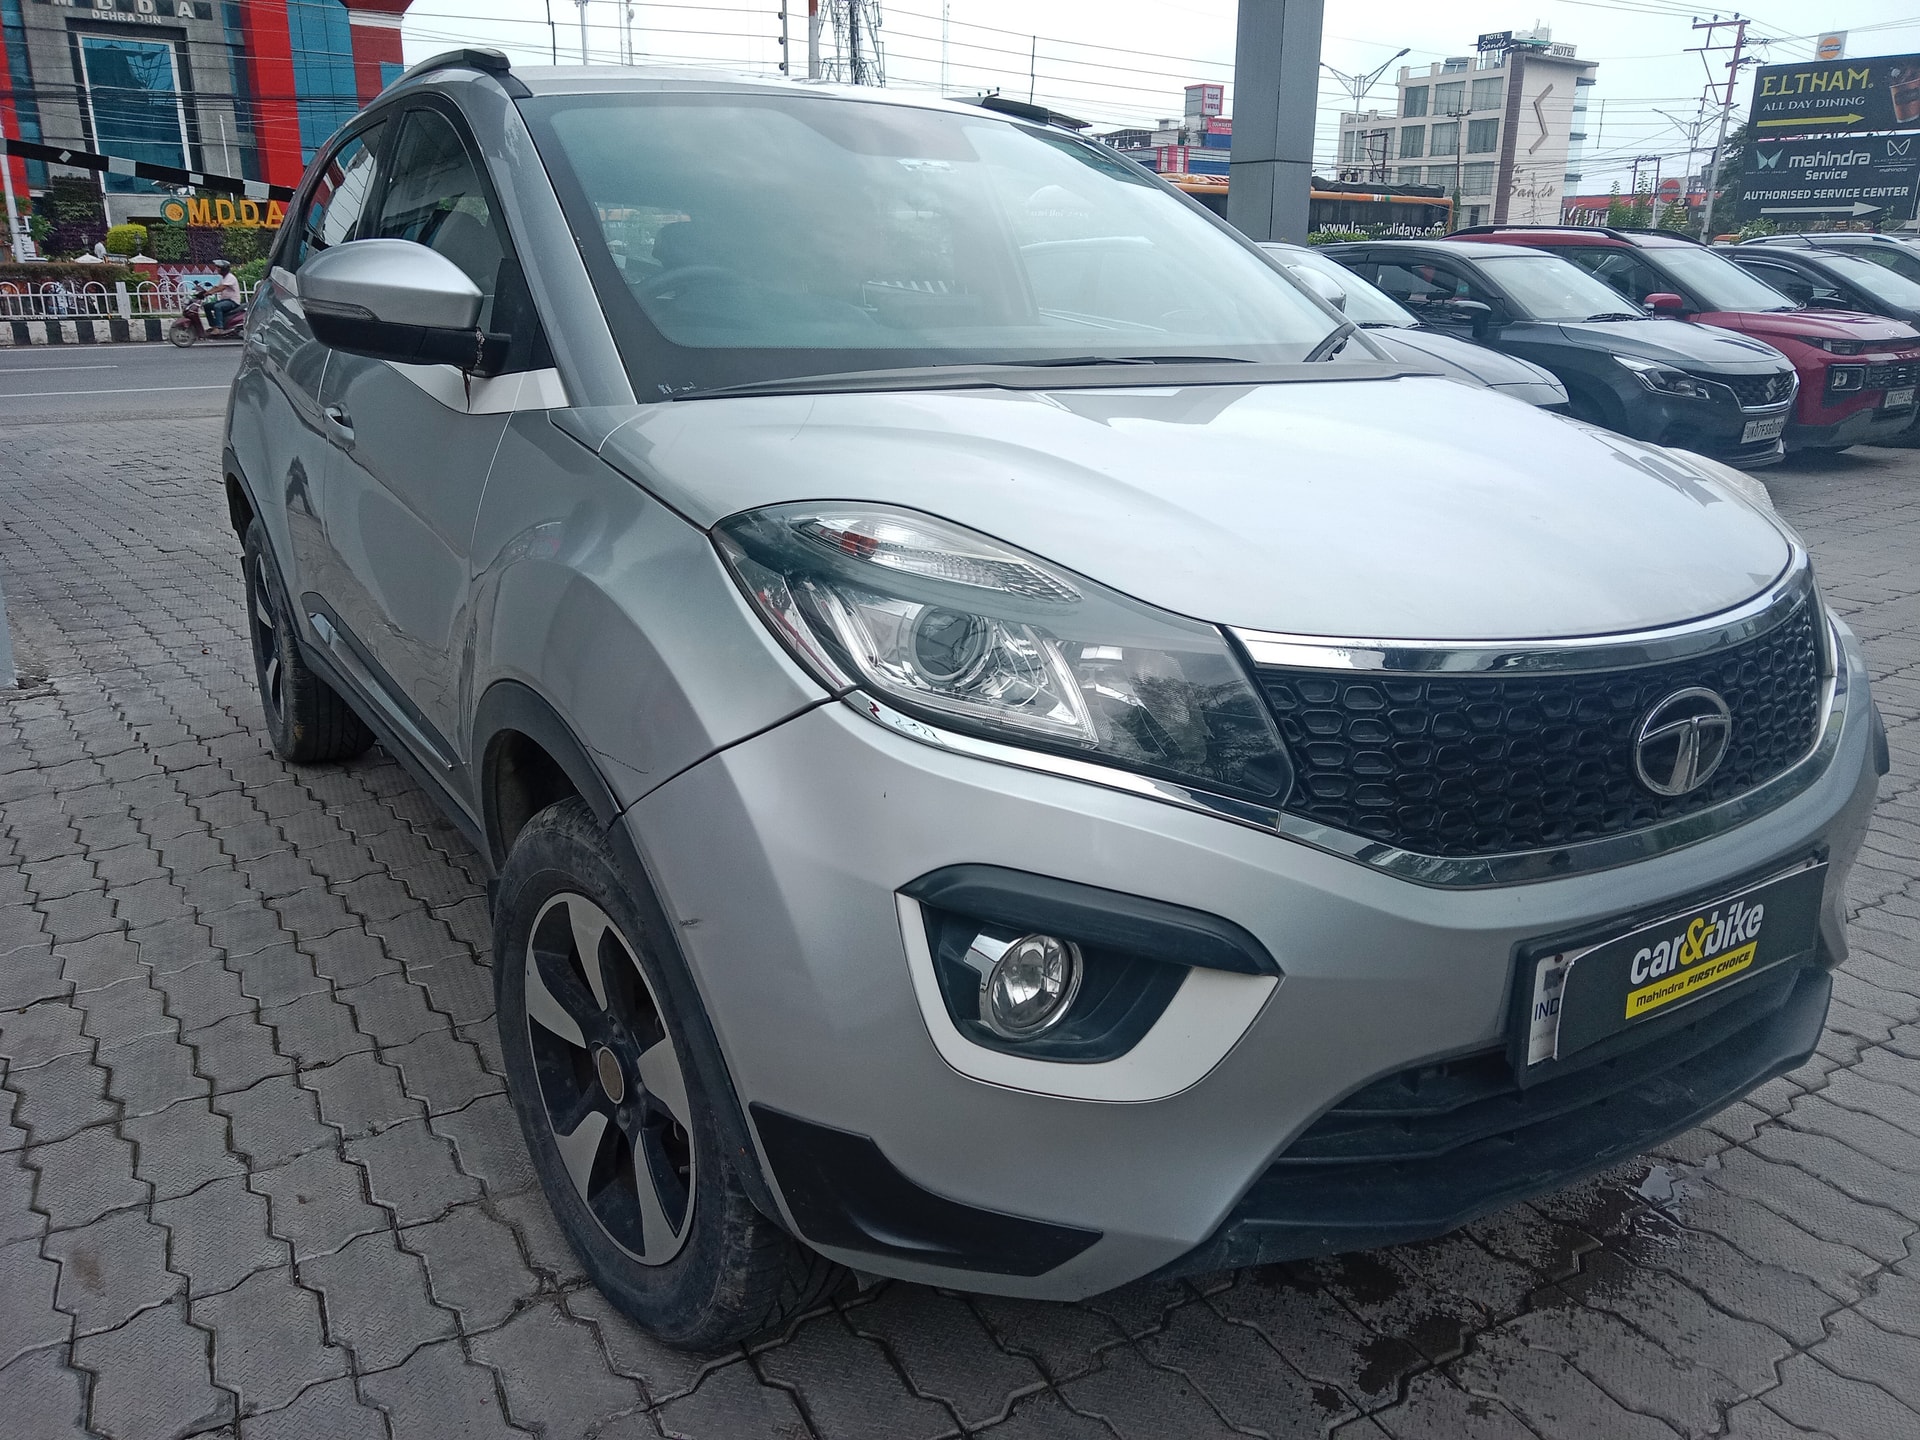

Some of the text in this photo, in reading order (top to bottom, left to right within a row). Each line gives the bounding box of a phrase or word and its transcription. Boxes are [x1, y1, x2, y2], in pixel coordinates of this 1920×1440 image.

[91, 9, 162, 24] DEHRADUN
[1485, 33, 1504, 41] HOTEL
[1552, 45, 1576, 58] HOTEL
[1759, 67, 1870, 97] ELTHAM
[1763, 96, 1865, 111] ALL DAY DINING
[1788, 150, 1871, 168] mahindra
[1805, 168, 1848, 181] Service
[1743, 186, 1909, 201] AUTHORISED SERVICE CENTER
[1319, 221, 1446, 239] www.laolidays.com
[1636, 950, 1751, 1008] Mahindra FIRST CHOICE
[1534, 997, 1560, 1022] IND
